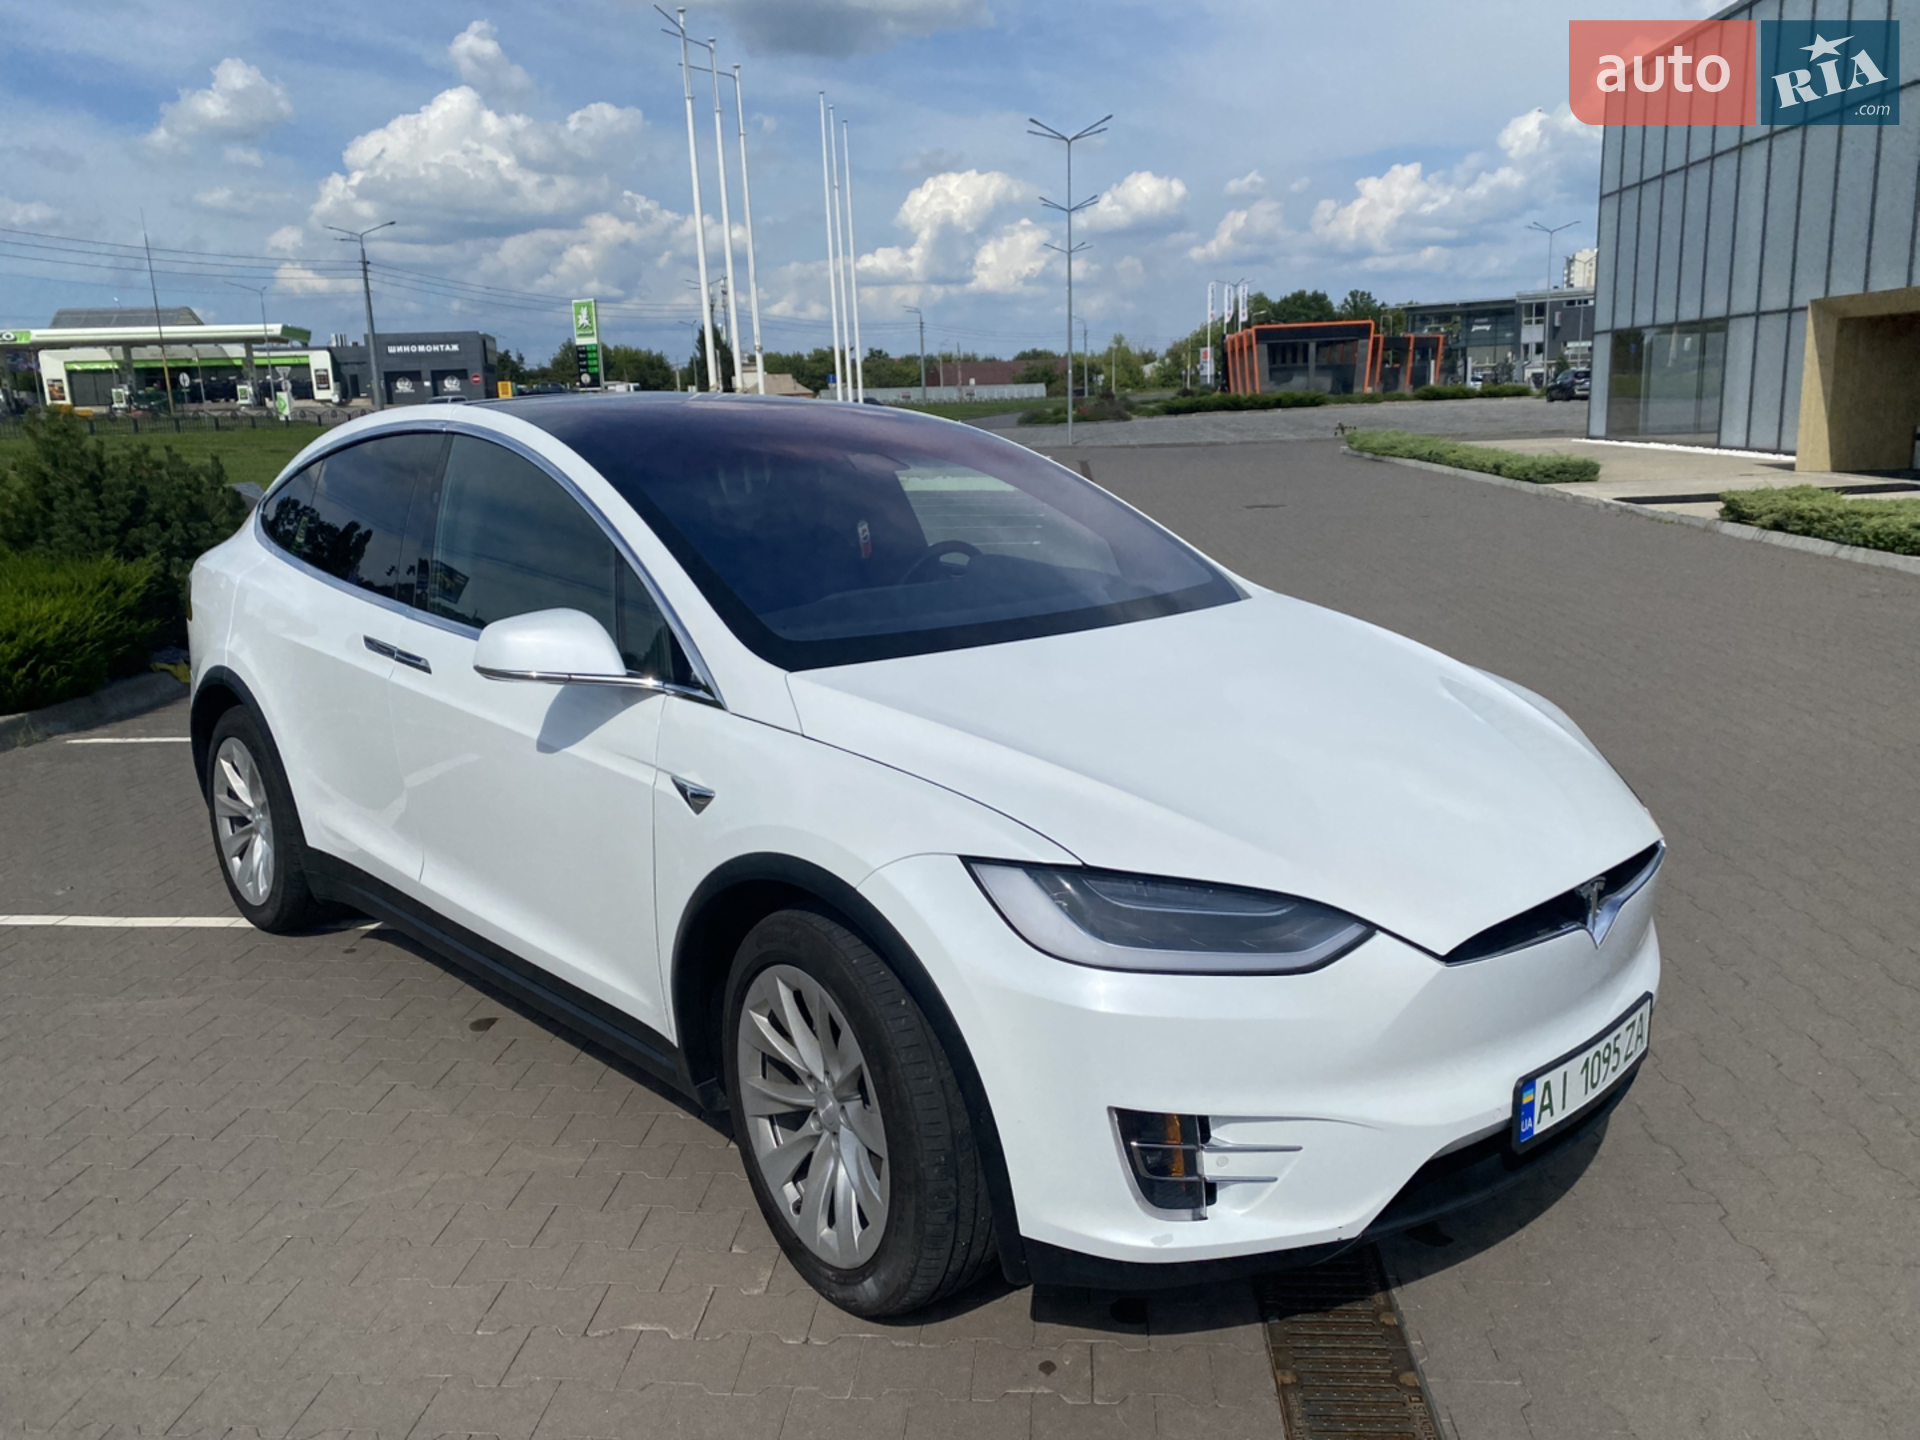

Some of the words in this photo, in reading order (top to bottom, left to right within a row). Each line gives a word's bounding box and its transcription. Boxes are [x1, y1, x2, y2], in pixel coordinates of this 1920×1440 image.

[387, 343, 460, 354] ШИНОМОНТАЖ
[1536, 1070, 1568, 1125] AI
[1580, 1033, 1621, 1096] 1095
[1623, 1012, 1644, 1064] ZA
[1520, 1116, 1533, 1133] UA
